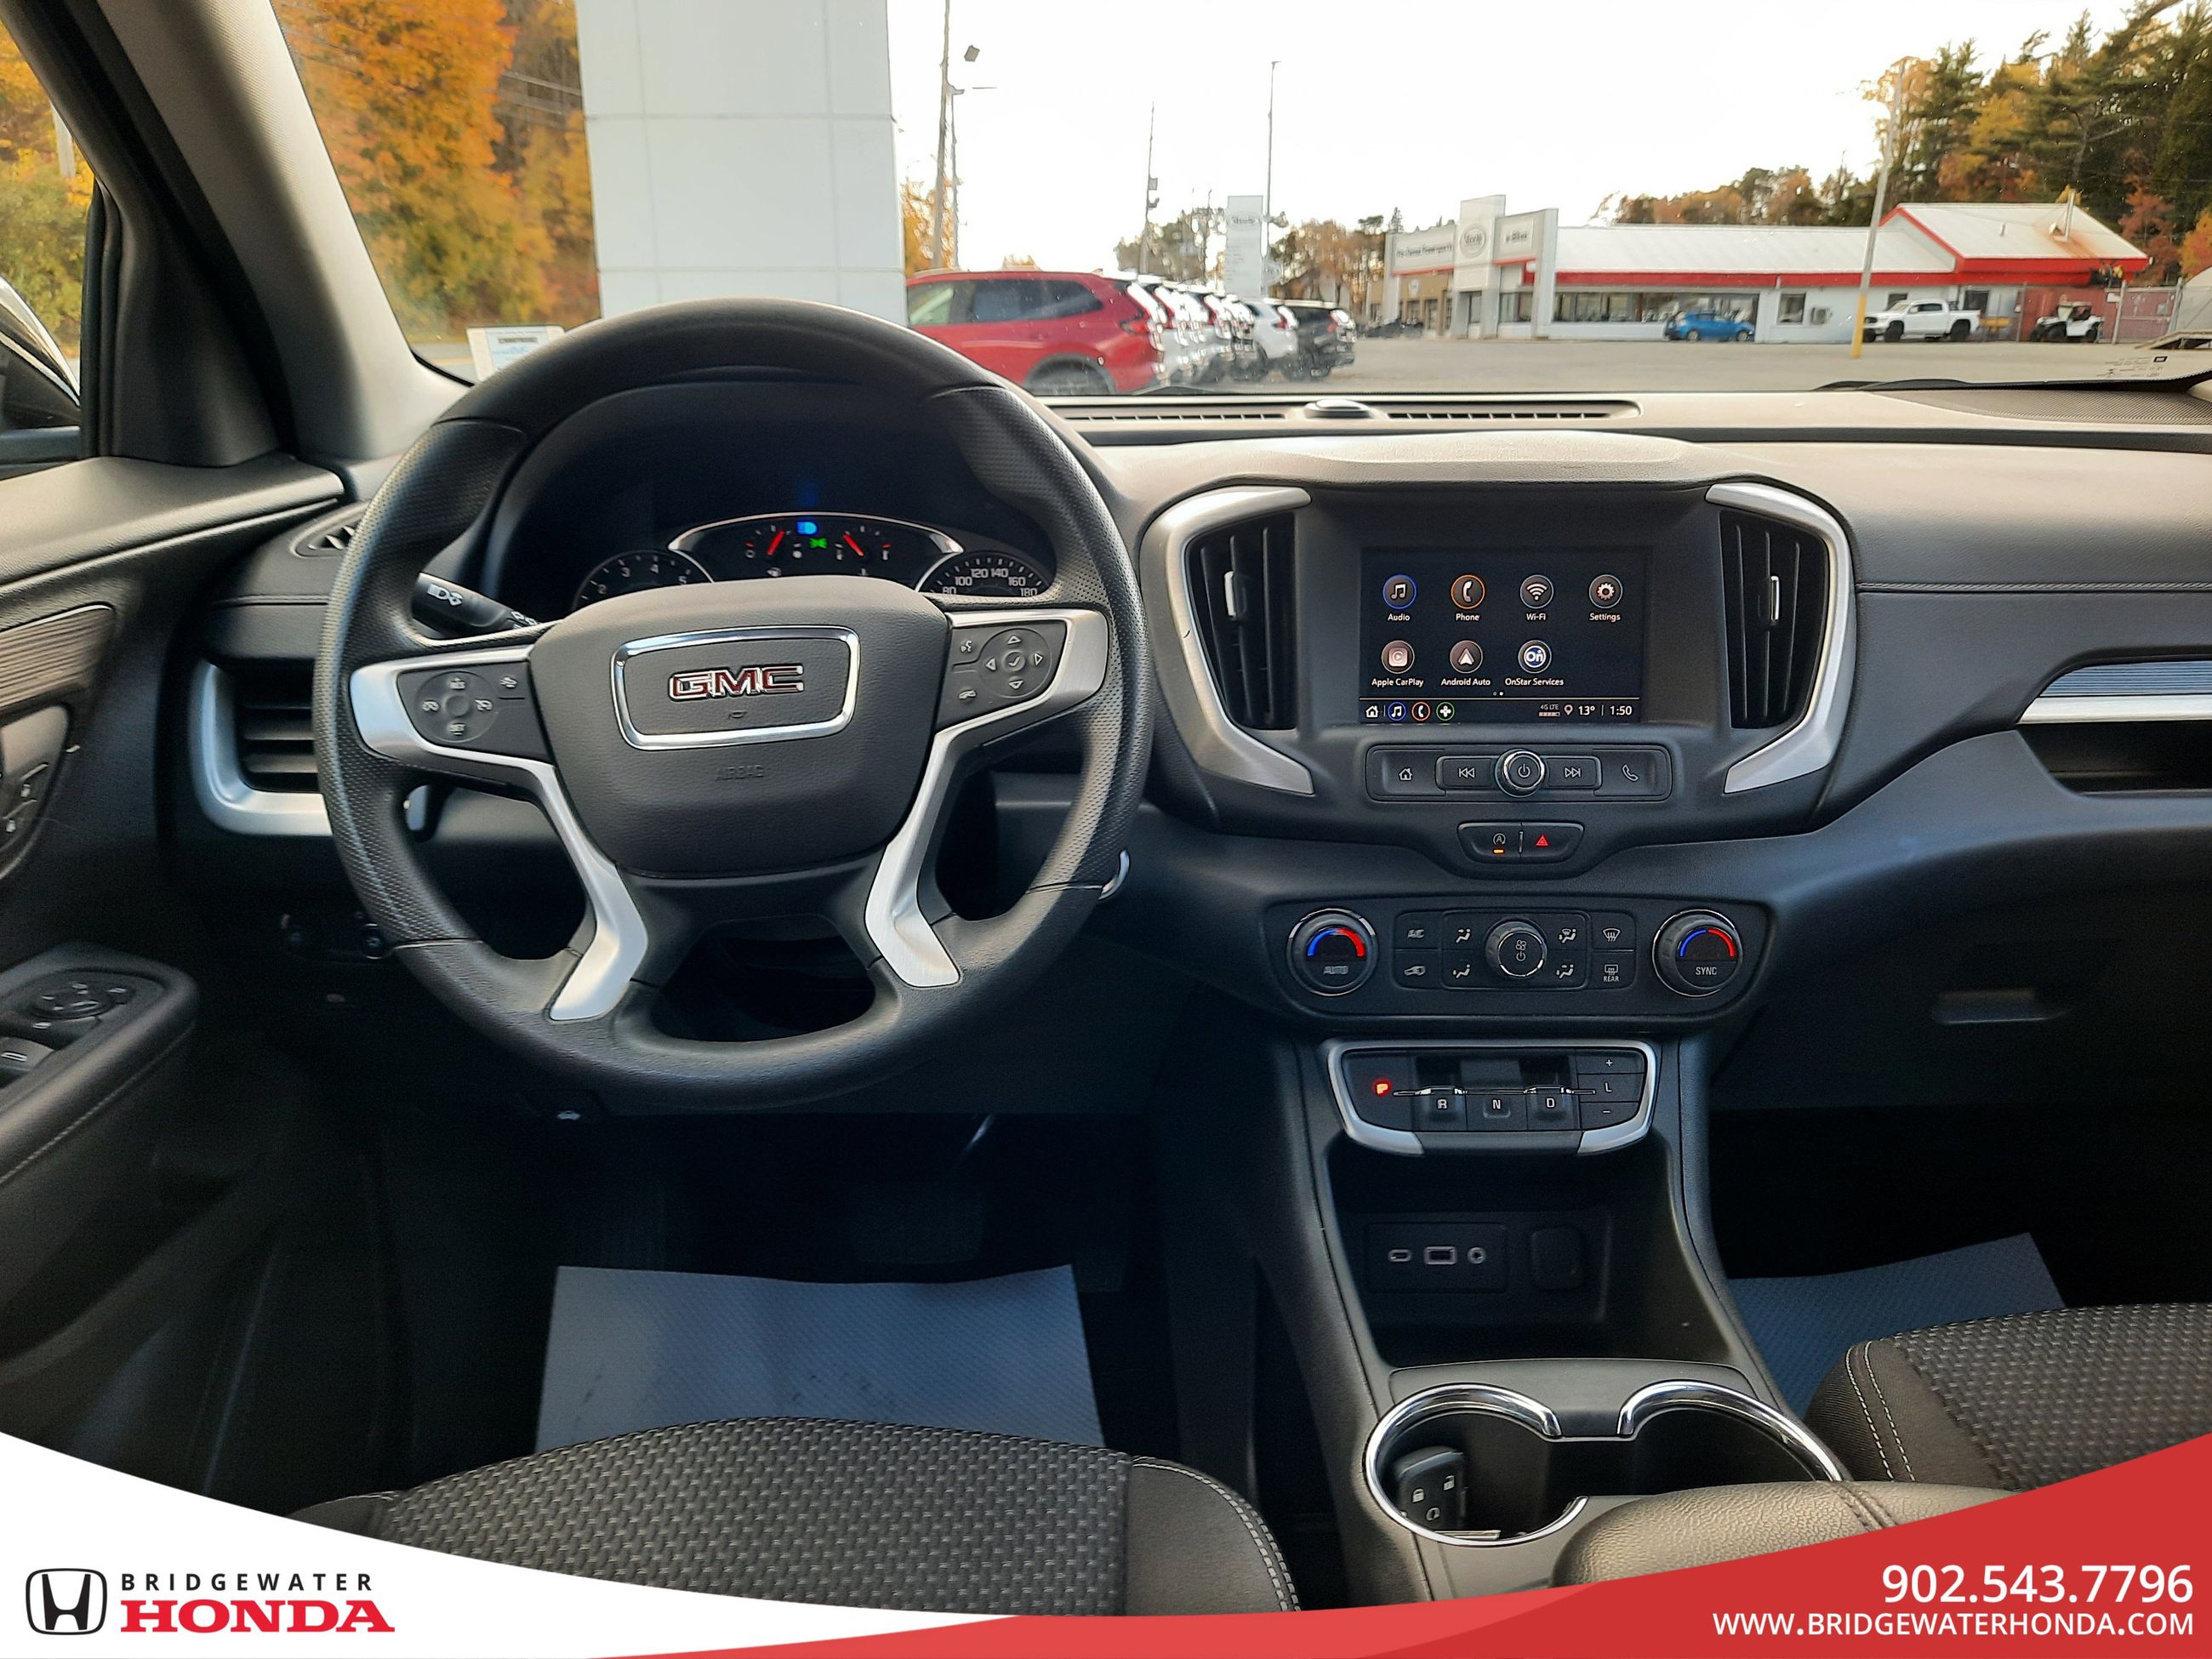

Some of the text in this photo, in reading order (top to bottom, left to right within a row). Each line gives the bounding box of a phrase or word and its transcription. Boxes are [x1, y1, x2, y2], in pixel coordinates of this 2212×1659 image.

[622, 567, 630, 577] 3
[649, 564, 658, 573] 4
[972, 568, 989, 578] 120
[991, 568, 1008, 577] 140
[955, 577, 972, 586] 100
[1008, 577, 1025, 586] 160
[598, 584, 606, 594] 2
[1021, 588, 1037, 596] 180
[1589, 613, 1621, 623] Settings
[669, 664, 804, 701] GMC
[1371, 679, 1424, 687] Apple CarPlay
[1578, 706, 1595, 715] 13°
[1610, 706, 1632, 715] 1:50
[1696, 966, 1717, 977] SYNC
[1603, 974, 1619, 983] REAR
[1377, 1083, 1388, 1094] P
[1605, 1081, 1612, 1092] L
[1437, 1098, 1447, 1109] R
[1492, 1099, 1501, 1109] N
[1546, 1097, 1555, 1109] D
